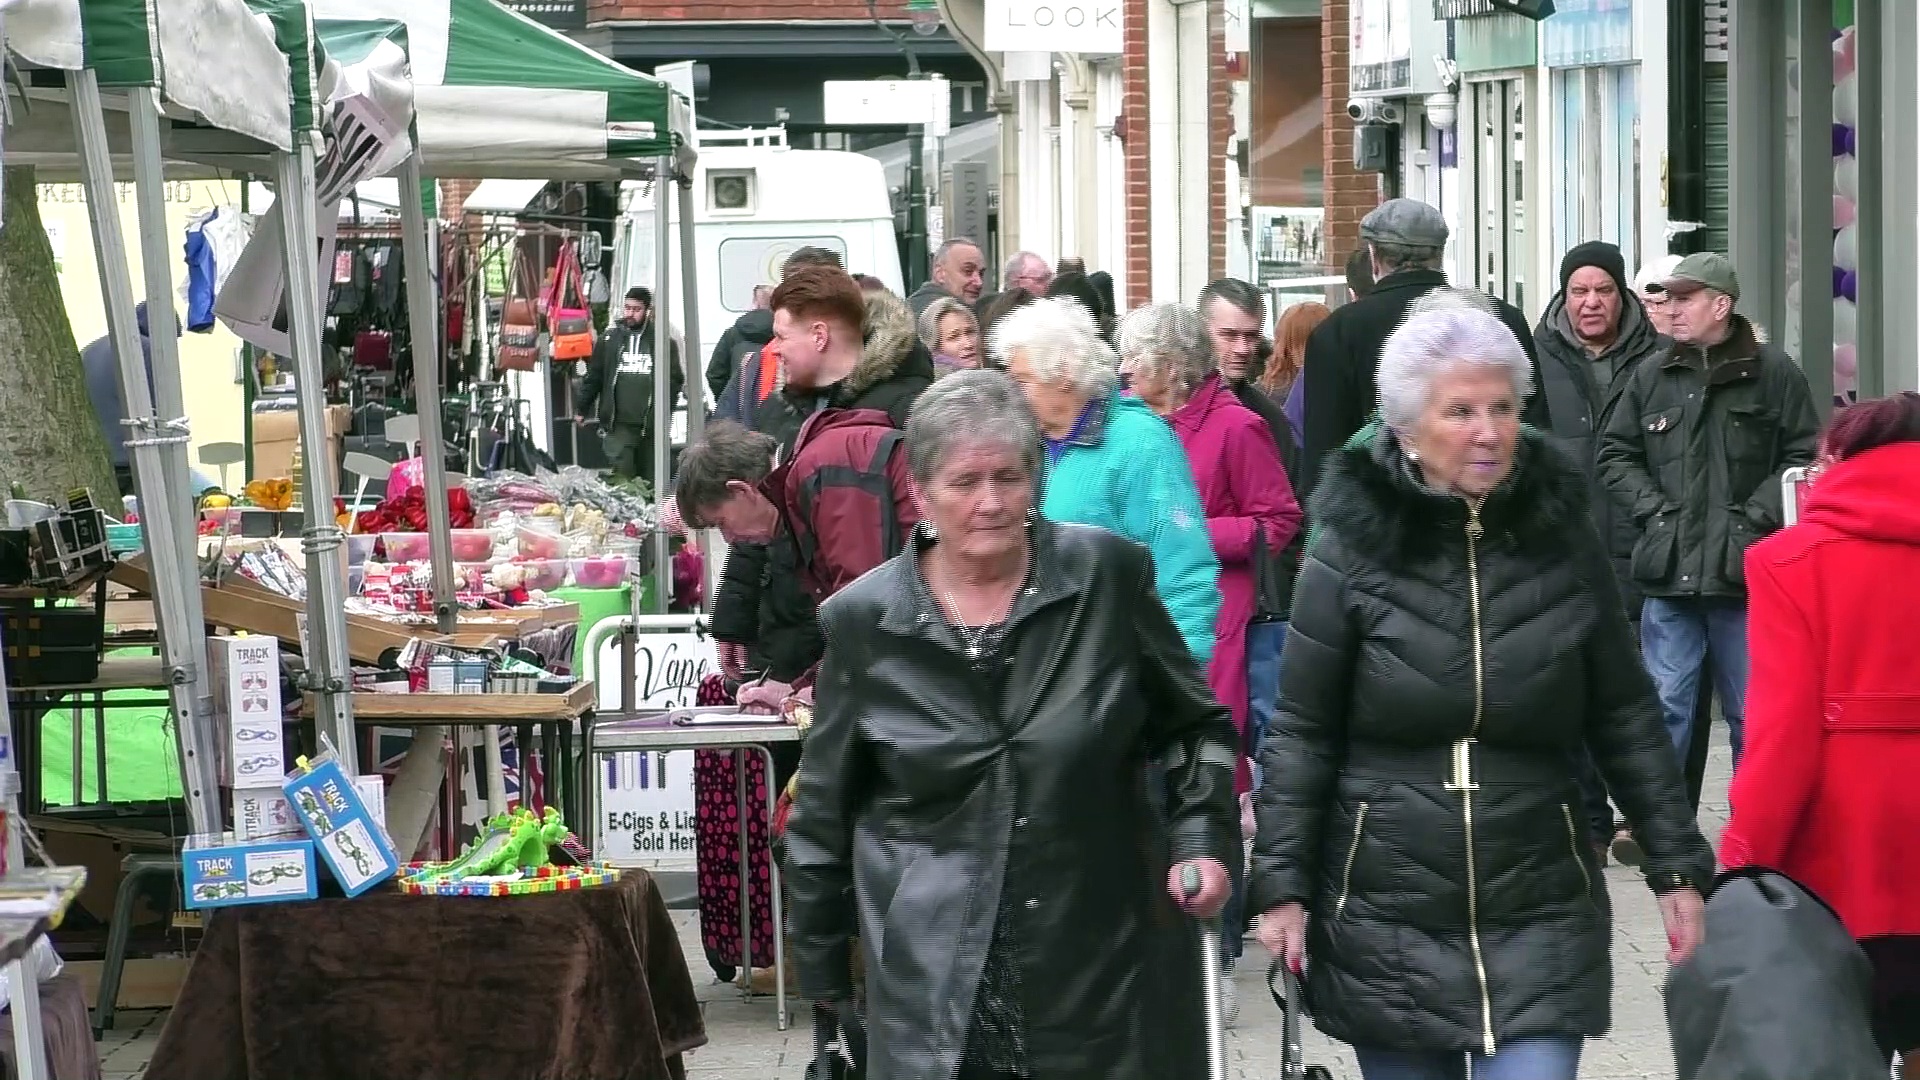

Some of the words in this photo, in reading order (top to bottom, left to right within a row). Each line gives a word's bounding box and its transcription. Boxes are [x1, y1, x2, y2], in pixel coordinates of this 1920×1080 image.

[1008, 6, 1117, 28] LOOK
[236, 647, 270, 660] TRACK
[634, 642, 711, 702] Vape
[322, 778, 349, 813] TRACK
[243, 798, 256, 834] TRACK
[608, 811, 654, 834] E-Cigs
[660, 811, 670, 830] &
[633, 832, 664, 851] Sold
[197, 857, 234, 872] TRACK
